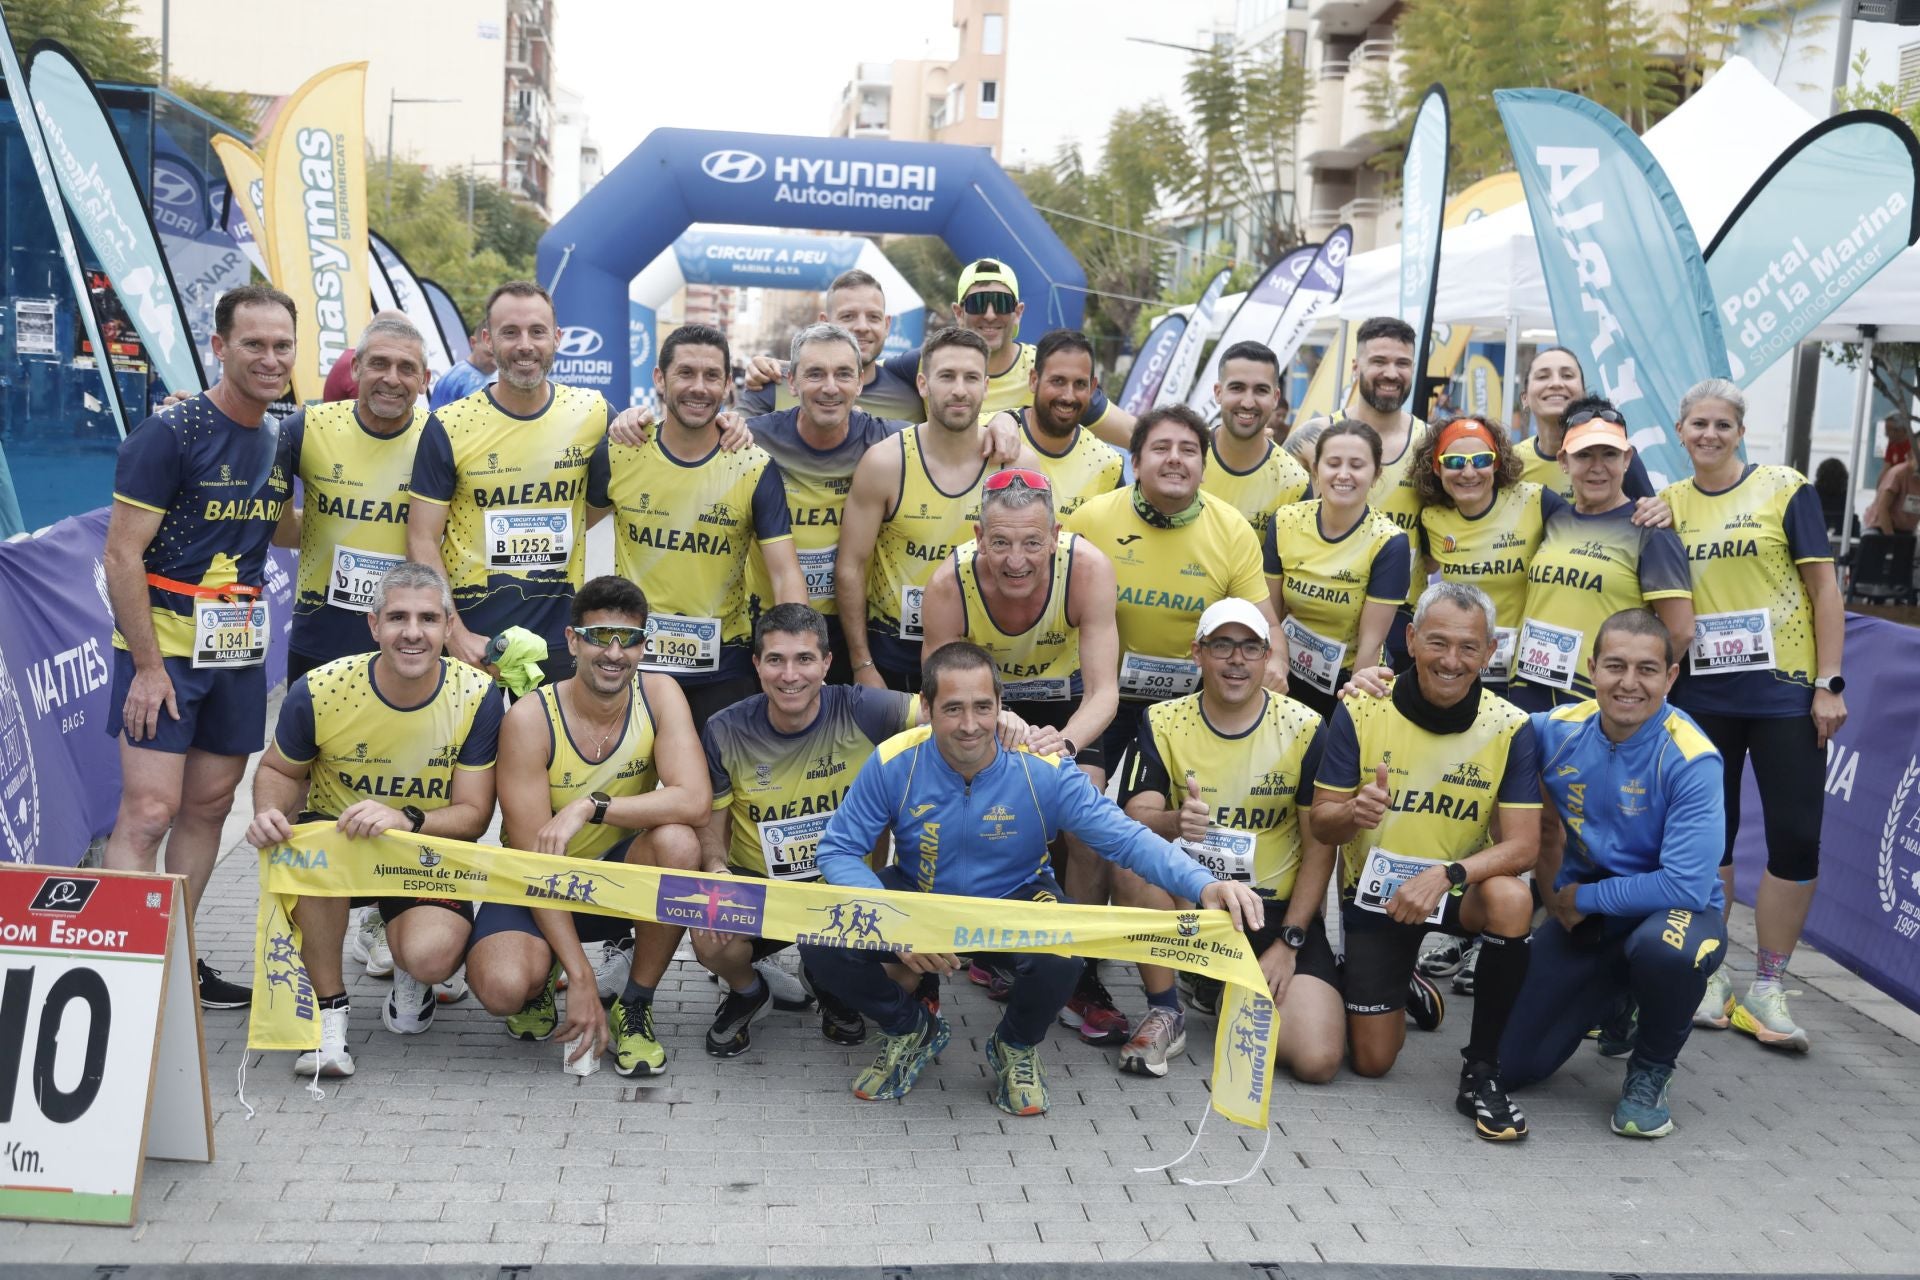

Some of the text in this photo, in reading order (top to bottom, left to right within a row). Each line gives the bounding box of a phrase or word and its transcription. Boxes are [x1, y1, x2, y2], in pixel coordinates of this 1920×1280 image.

[774, 156, 937, 192] HYUNDAI
[336, 134, 351, 240] SUPERMERCATS
[774, 183, 935, 212] Autoalmenar
[296, 127, 350, 377] masymas
[706, 244, 827, 265] CIRCUIT A PEU
[773, 265, 800, 275] ALTA
[1739, 189, 1908, 349] de la Marina
[1720, 236, 1810, 327] Portal
[496, 537, 550, 554] B 1252
[628, 522, 732, 556] BALEARIA
[509, 554, 551, 563] BALEARIA
[1443, 557, 1525, 575] BALEARIA
[1286, 576, 1351, 604] BALEARIA
[911, 613, 919, 624] S
[205, 632, 249, 649] C 1341
[644, 639, 697, 657] C 1340
[1713, 638, 1744, 657] 109
[215, 650, 251, 659] BALEARIA
[656, 655, 697, 666] BALEARIA
[1297, 650, 1313, 669] 68
[1527, 648, 1551, 667] 286
[1709, 655, 1751, 666] BALEARIA
[26, 636, 108, 720] MATTIES
[1523, 661, 1551, 678] BALEARIA
[1144, 675, 1193, 688] 503 S
[62, 709, 85, 735] BAGS
[1250, 785, 1297, 796] DÉNIA CORRE
[1442, 773, 1492, 790] DÉNIA CORRE
[1210, 806, 1288, 829] EARIA
[784, 824, 806, 832] CIRCUIT
[794, 832, 818, 841] GUSTAVO
[1198, 854, 1226, 871] 863
[373, 864, 488, 882] Ajuntament de Dénia
[403, 879, 457, 893] ESPORTS
[1369, 880, 1381, 893] G
[666, 906, 756, 925] VOLTA A PEU
[1893, 913, 1920, 940] 1997
[953, 926, 1075, 949] BALEARIA
[1150, 946, 1210, 967] ESPORTS
[1193, 938, 1208, 950] de
[1210, 941, 1244, 960] Dénia
[0, 965, 112, 1124] 10
